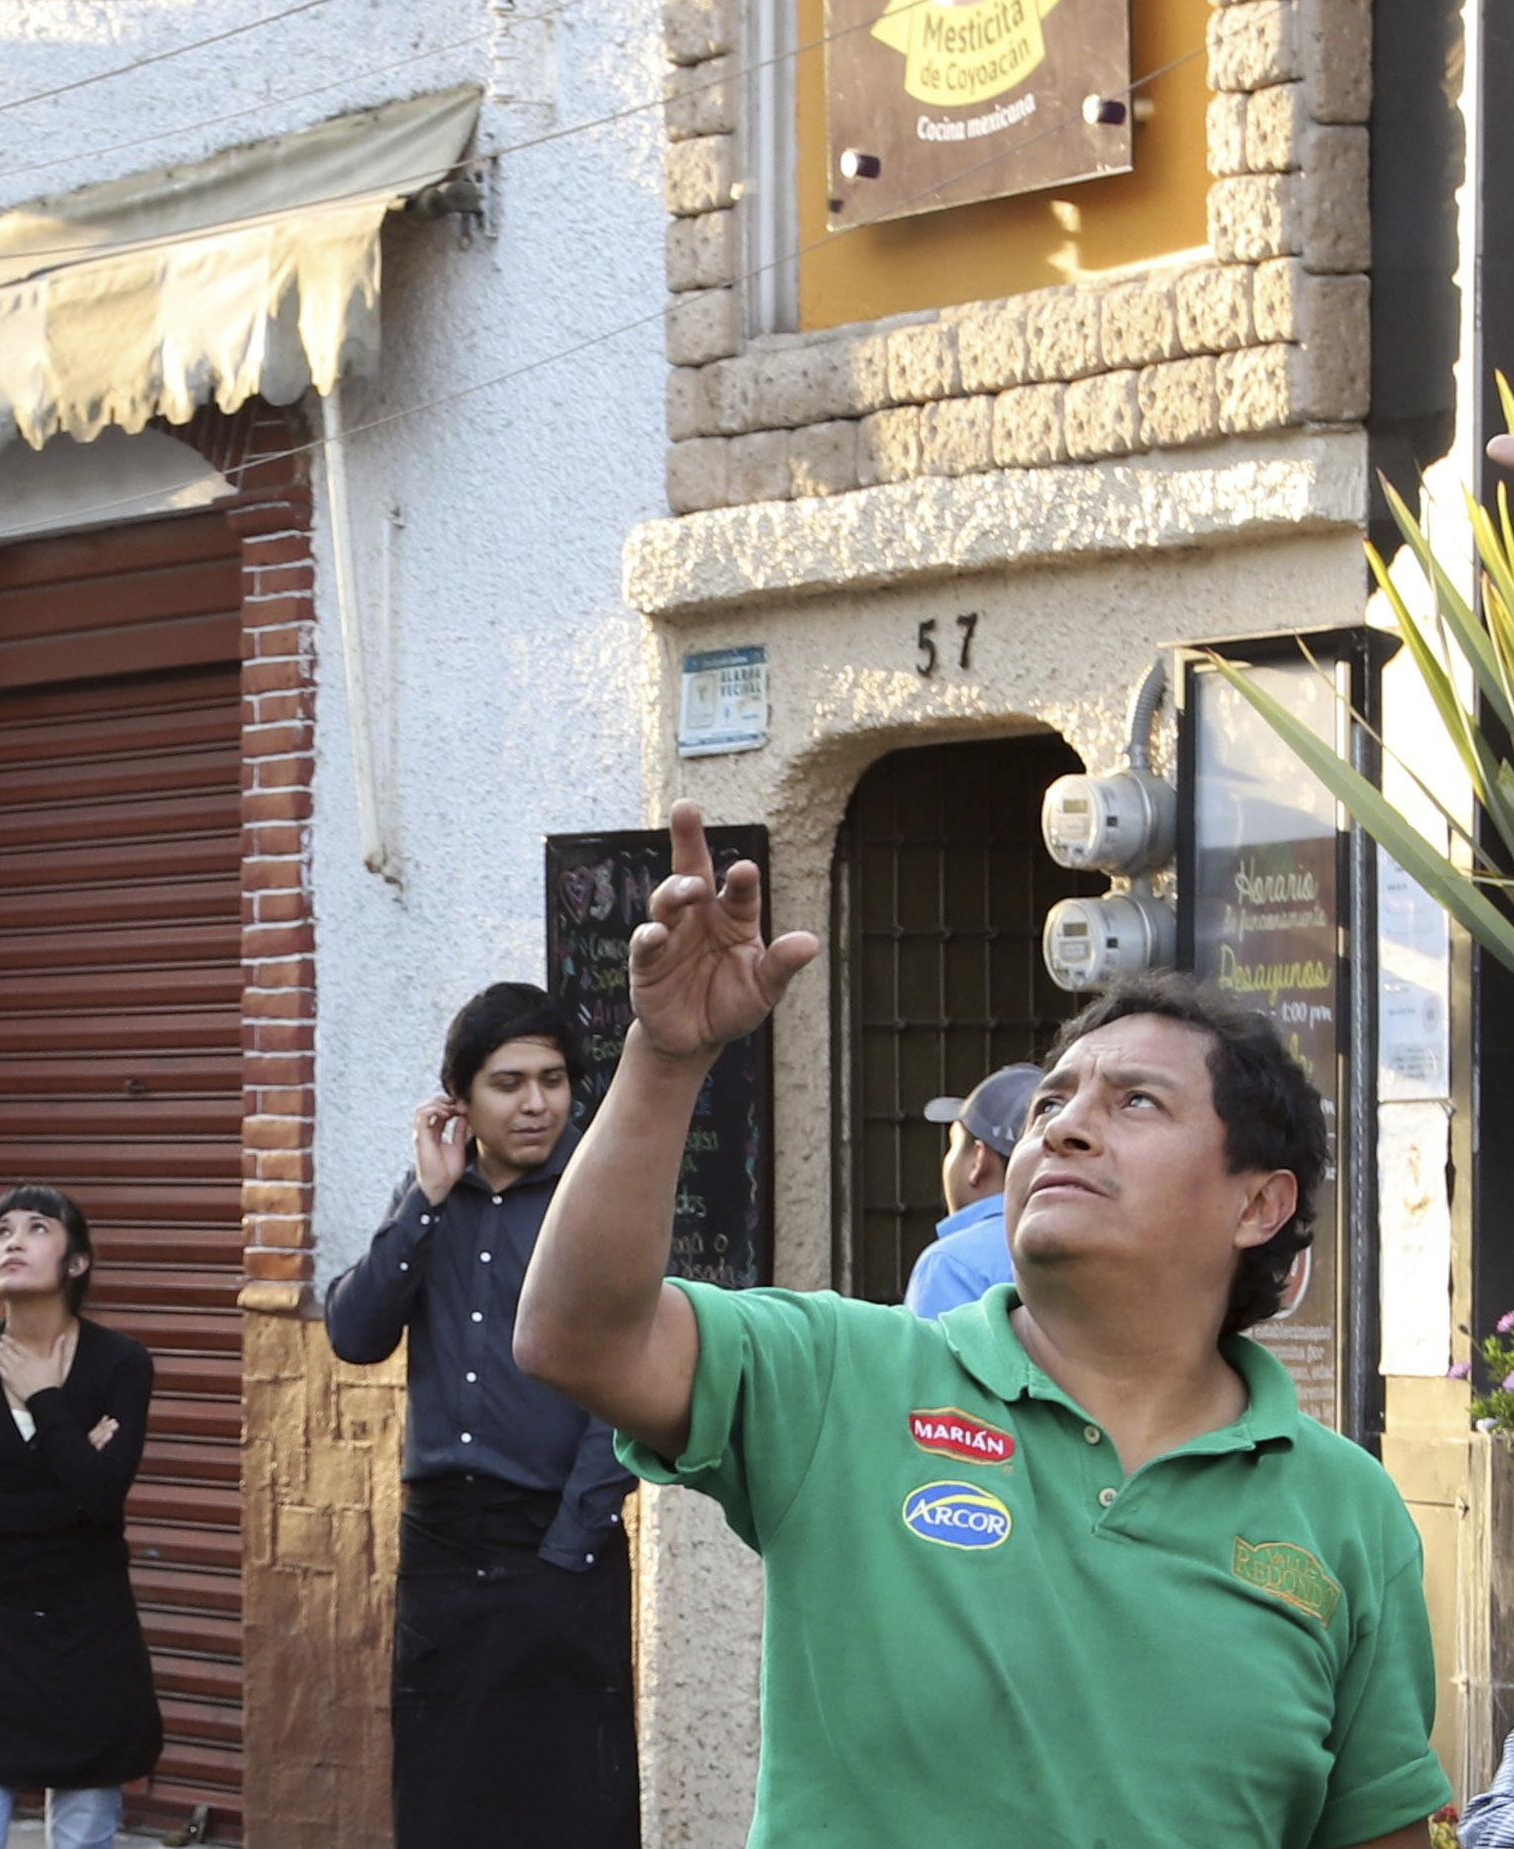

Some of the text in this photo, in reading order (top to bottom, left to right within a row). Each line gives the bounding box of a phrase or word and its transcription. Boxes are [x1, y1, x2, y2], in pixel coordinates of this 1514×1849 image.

[923, 0, 1026, 53] Mesticita
[920, 60, 940, 90] de
[917, 92, 1037, 141] Cocina mexicana
[1234, 857, 1319, 905] Horario
[1219, 944, 1332, 1005] Desayunos
[914, 1419, 1004, 1455] MARIÁN
[905, 1498, 1006, 1537] ARCOR
